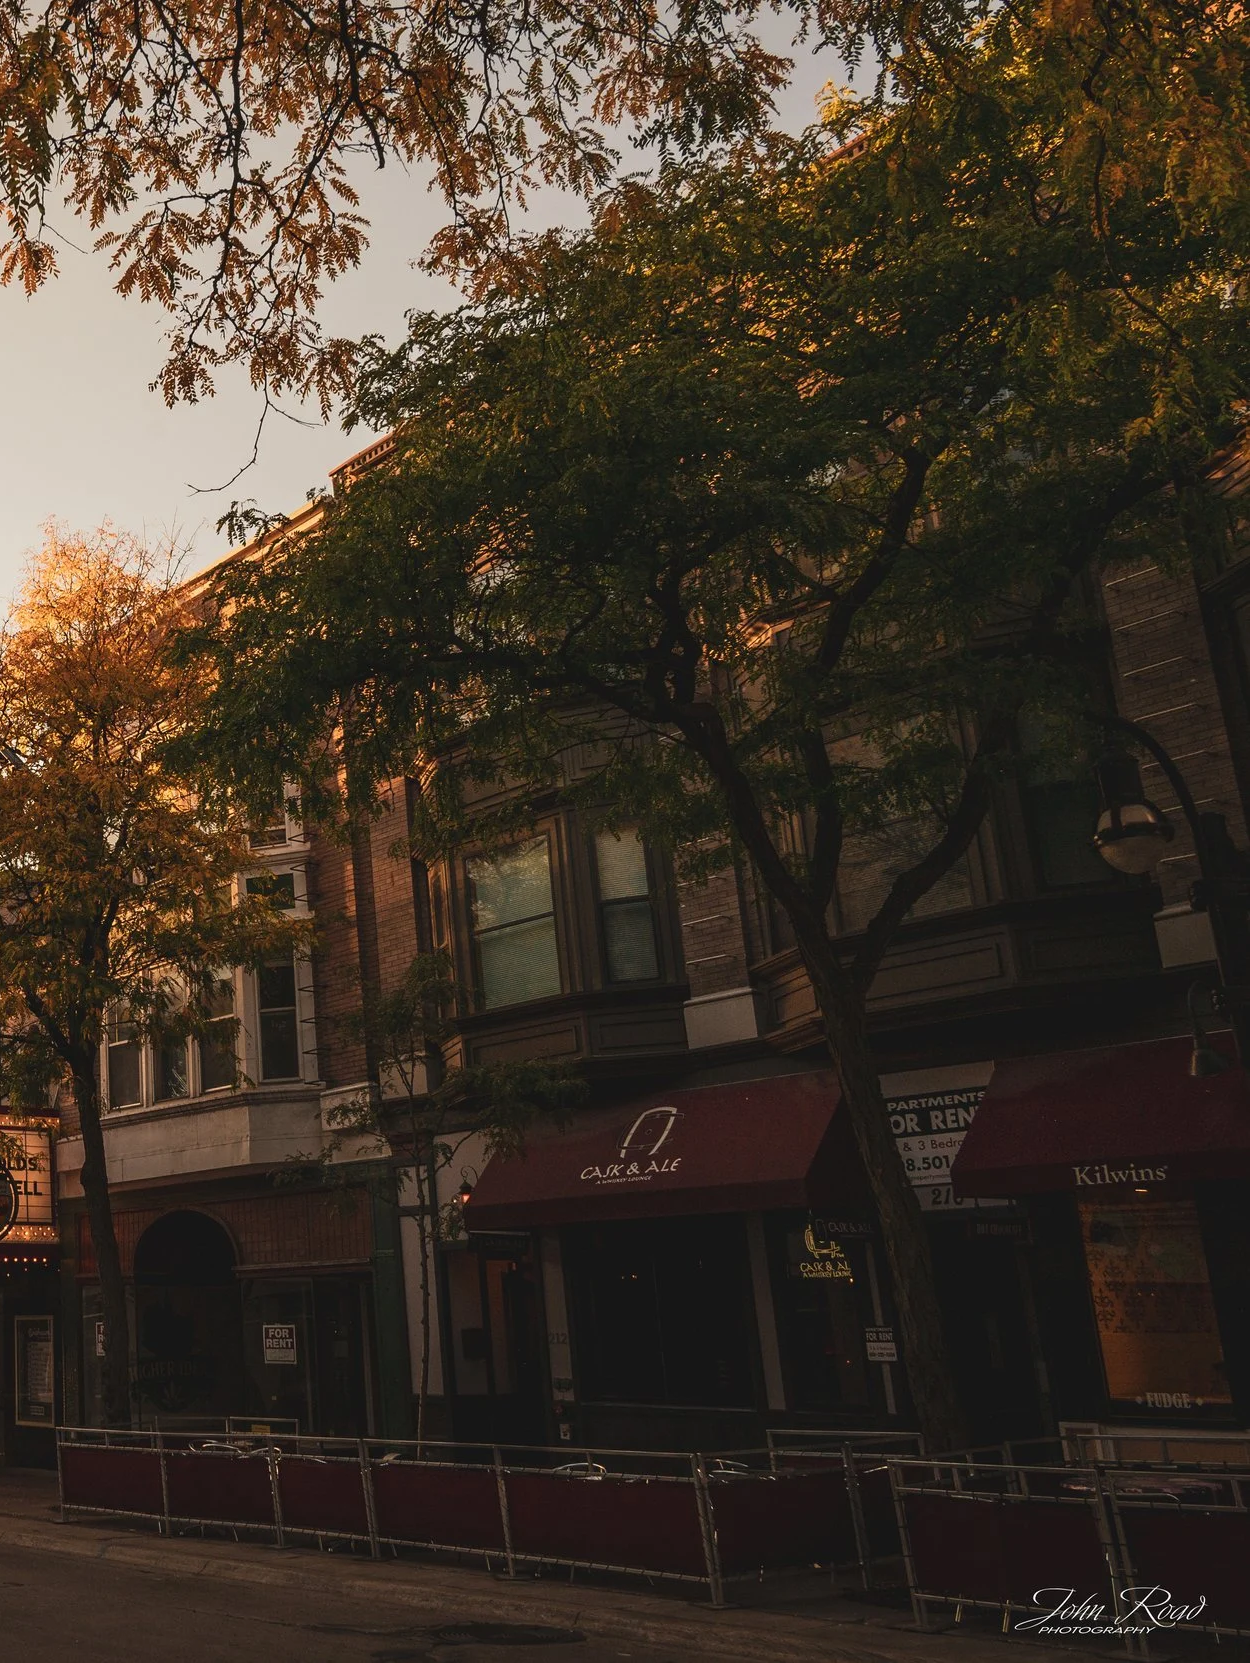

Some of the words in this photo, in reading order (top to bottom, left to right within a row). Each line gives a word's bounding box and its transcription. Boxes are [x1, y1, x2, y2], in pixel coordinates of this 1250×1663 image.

[886, 1091, 987, 1112] PARTMENTS
[889, 1113, 922, 1135] OR
[930, 1107, 976, 1131] REN
[903, 1142, 912, 1152] &
[918, 1141, 925, 1151] 3
[580, 1164, 625, 1180] CASK
[626, 1162, 640, 1175] &
[645, 1157, 682, 1174] ALE
[1071, 1163, 1167, 1186] Kilwins
[828, 1221, 848, 1233] CASK
[800, 1262, 824, 1272] CASK
[825, 1261, 833, 1271] &
[837, 1260, 852, 1270] AL
[268, 1329, 289, 1338] FOR
[866, 1333, 877, 1341] FOR
[878, 1333, 893, 1341] RENT
[266, 1338, 293, 1348] RENT
[1145, 1392, 1192, 1409] FUDGE
